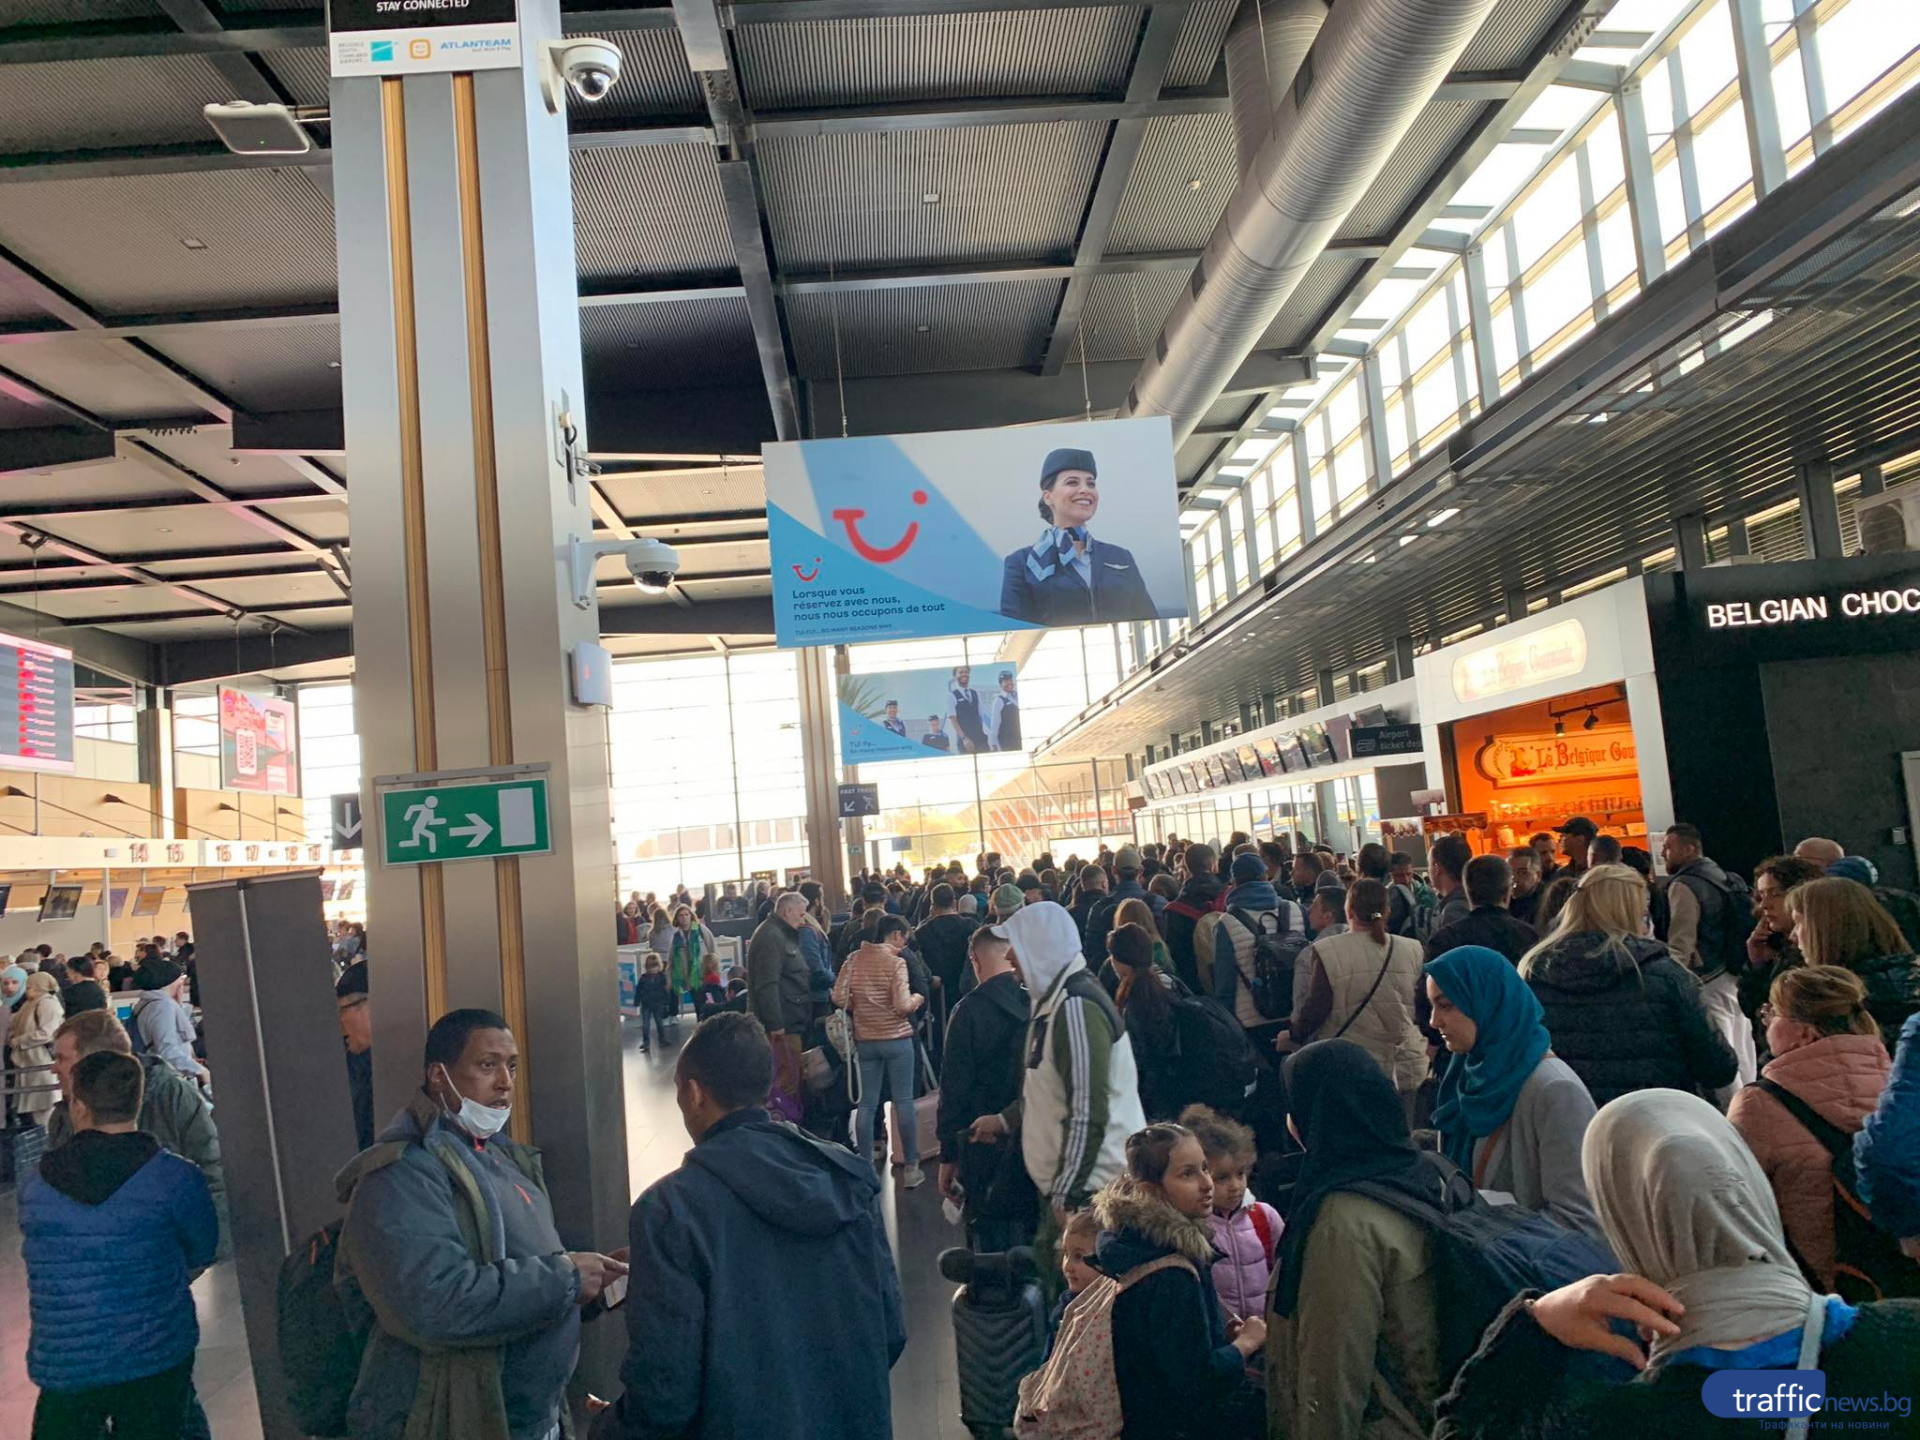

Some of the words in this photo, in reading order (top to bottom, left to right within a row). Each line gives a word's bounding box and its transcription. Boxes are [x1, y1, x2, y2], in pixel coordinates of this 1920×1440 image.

[376, 2, 400, 12] STAY
[403, 0, 469, 10] CONNECTED
[440, 38, 511, 49] ATLANTEAM
[793, 588, 837, 599] Lorsque
[840, 586, 865, 595] vous
[793, 600, 841, 610] réservez
[844, 598, 869, 606] avec
[871, 595, 900, 605] nous,
[1707, 596, 1828, 627] BELGIAN
[1842, 589, 1920, 616] CHOC
[794, 612, 821, 621] nous
[823, 610, 849, 619] nous
[852, 606, 903, 617] occupons
[906, 604, 919, 613] de
[922, 603, 945, 612] tout
[1379, 730, 1409, 740] Airport
[1537, 747, 1553, 768] La
[1555, 741, 1606, 768] Belgique
